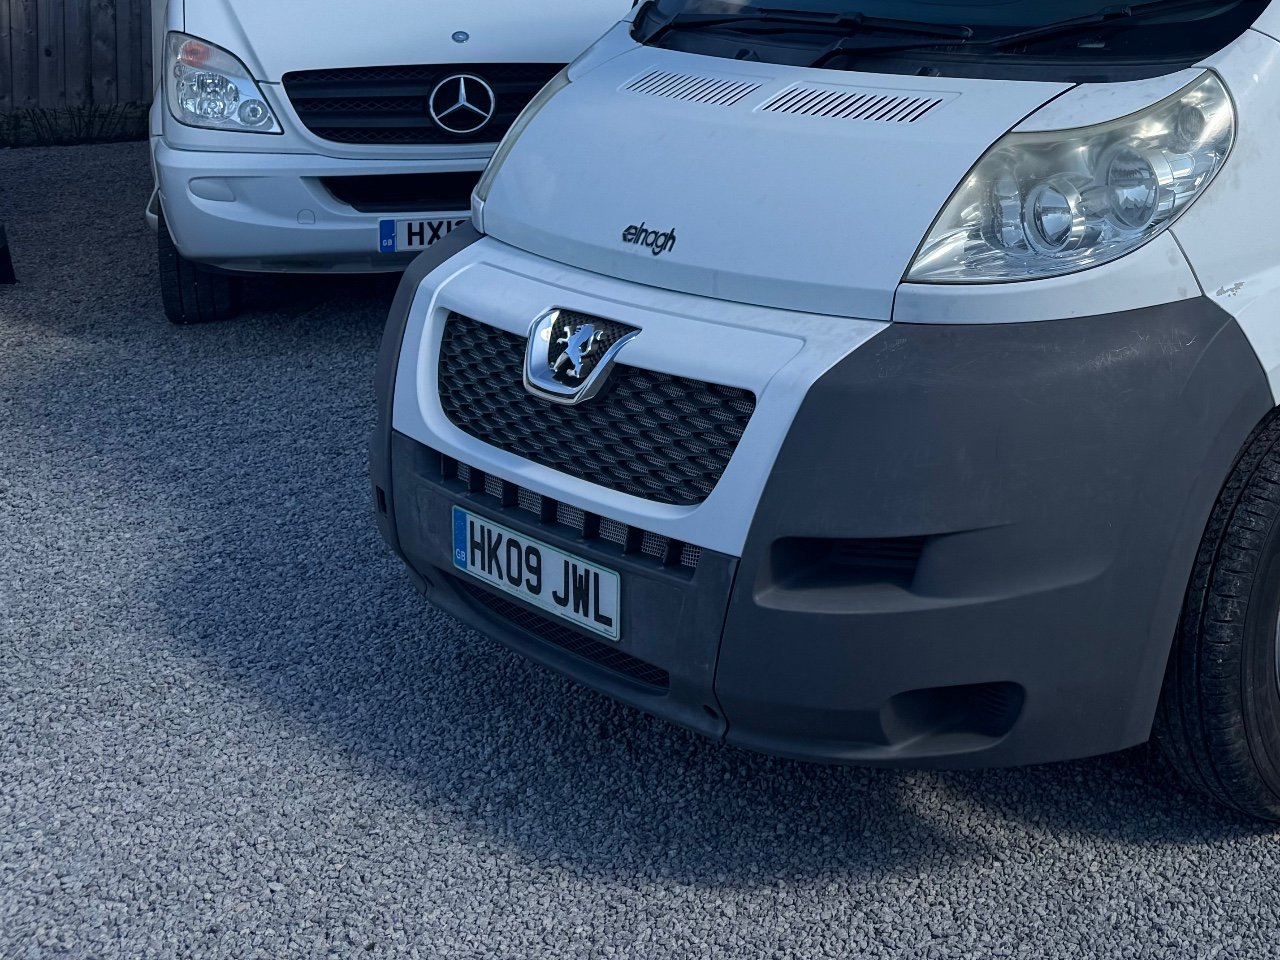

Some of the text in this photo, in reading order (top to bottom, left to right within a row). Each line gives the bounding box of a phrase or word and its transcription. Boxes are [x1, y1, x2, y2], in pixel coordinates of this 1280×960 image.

[407, 220, 466, 246] HX
[622, 221, 676, 256] elnagh
[455, 550, 466, 562] GB
[469, 520, 542, 596] HK09
[552, 560, 613, 628] JWL
